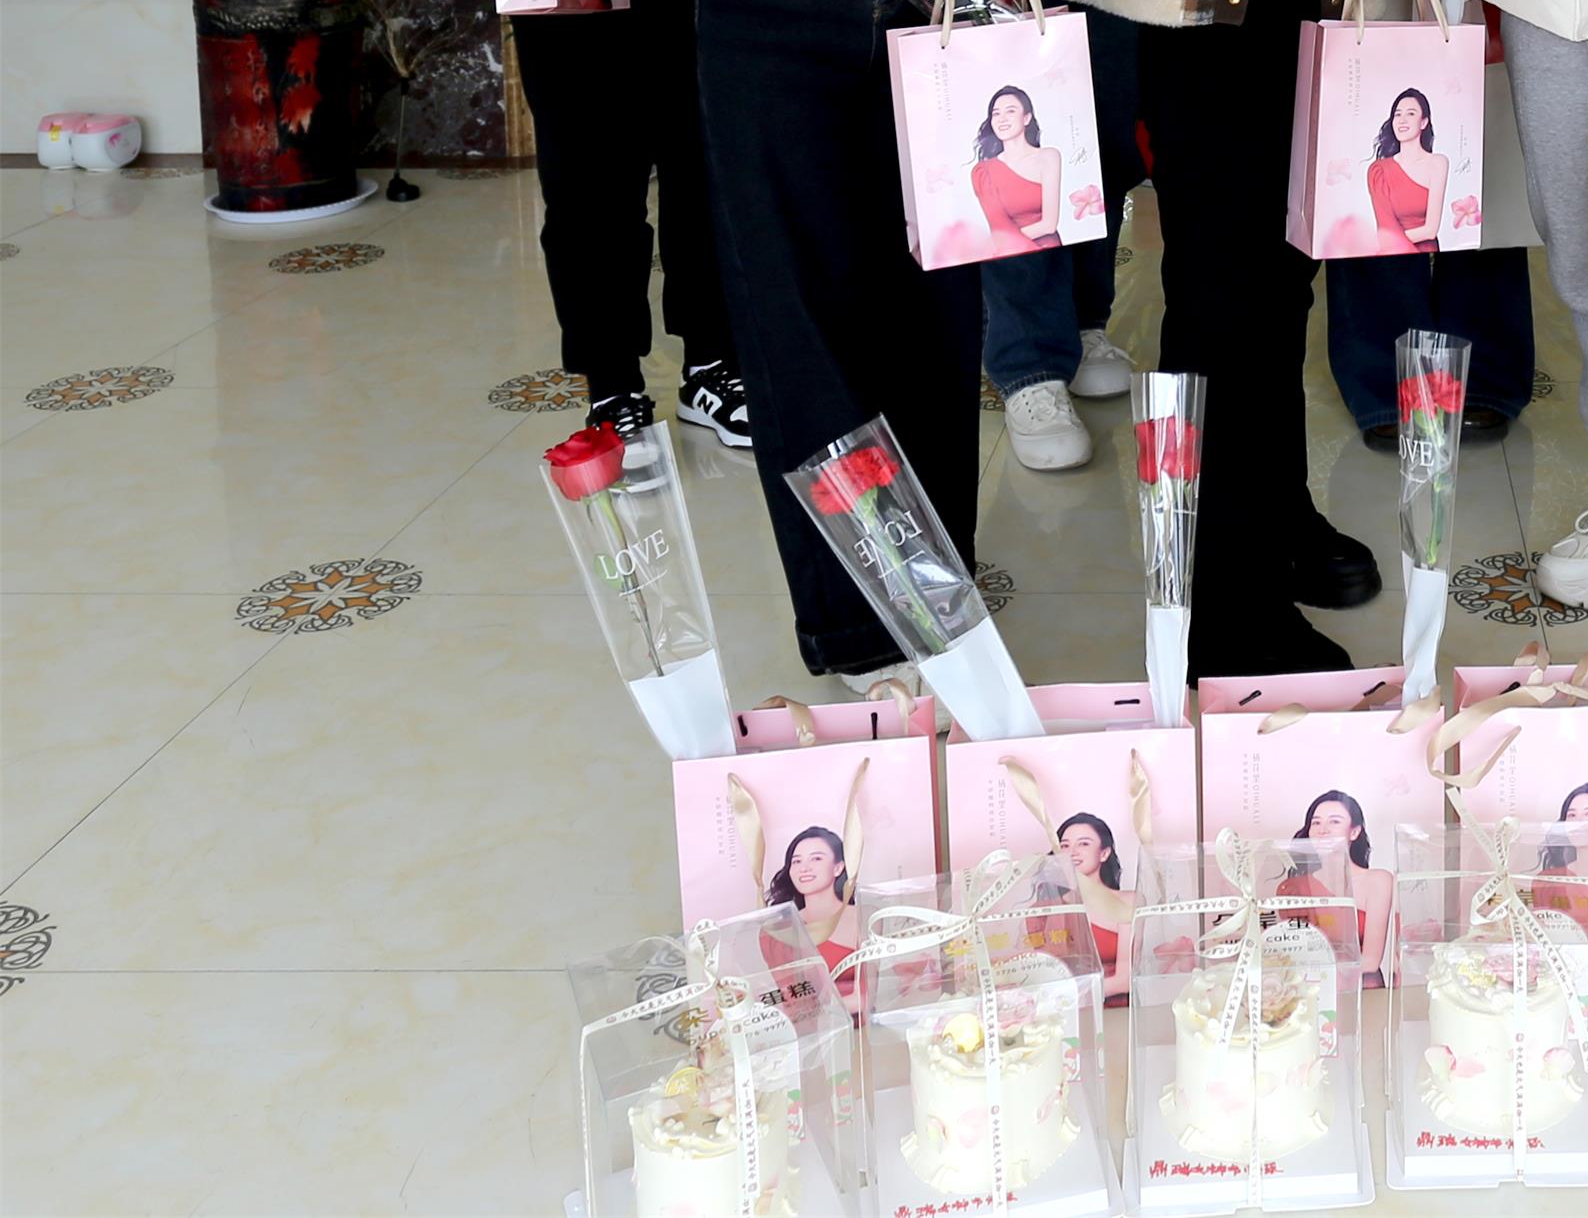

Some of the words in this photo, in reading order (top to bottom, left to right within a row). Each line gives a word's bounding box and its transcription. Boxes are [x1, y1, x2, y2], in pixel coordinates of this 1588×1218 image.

[696, 393, 714, 415] N
[1399, 436, 1435, 468] OVE
[598, 529, 670, 580] LOVE
[759, 980, 817, 1008] 蛋糕
